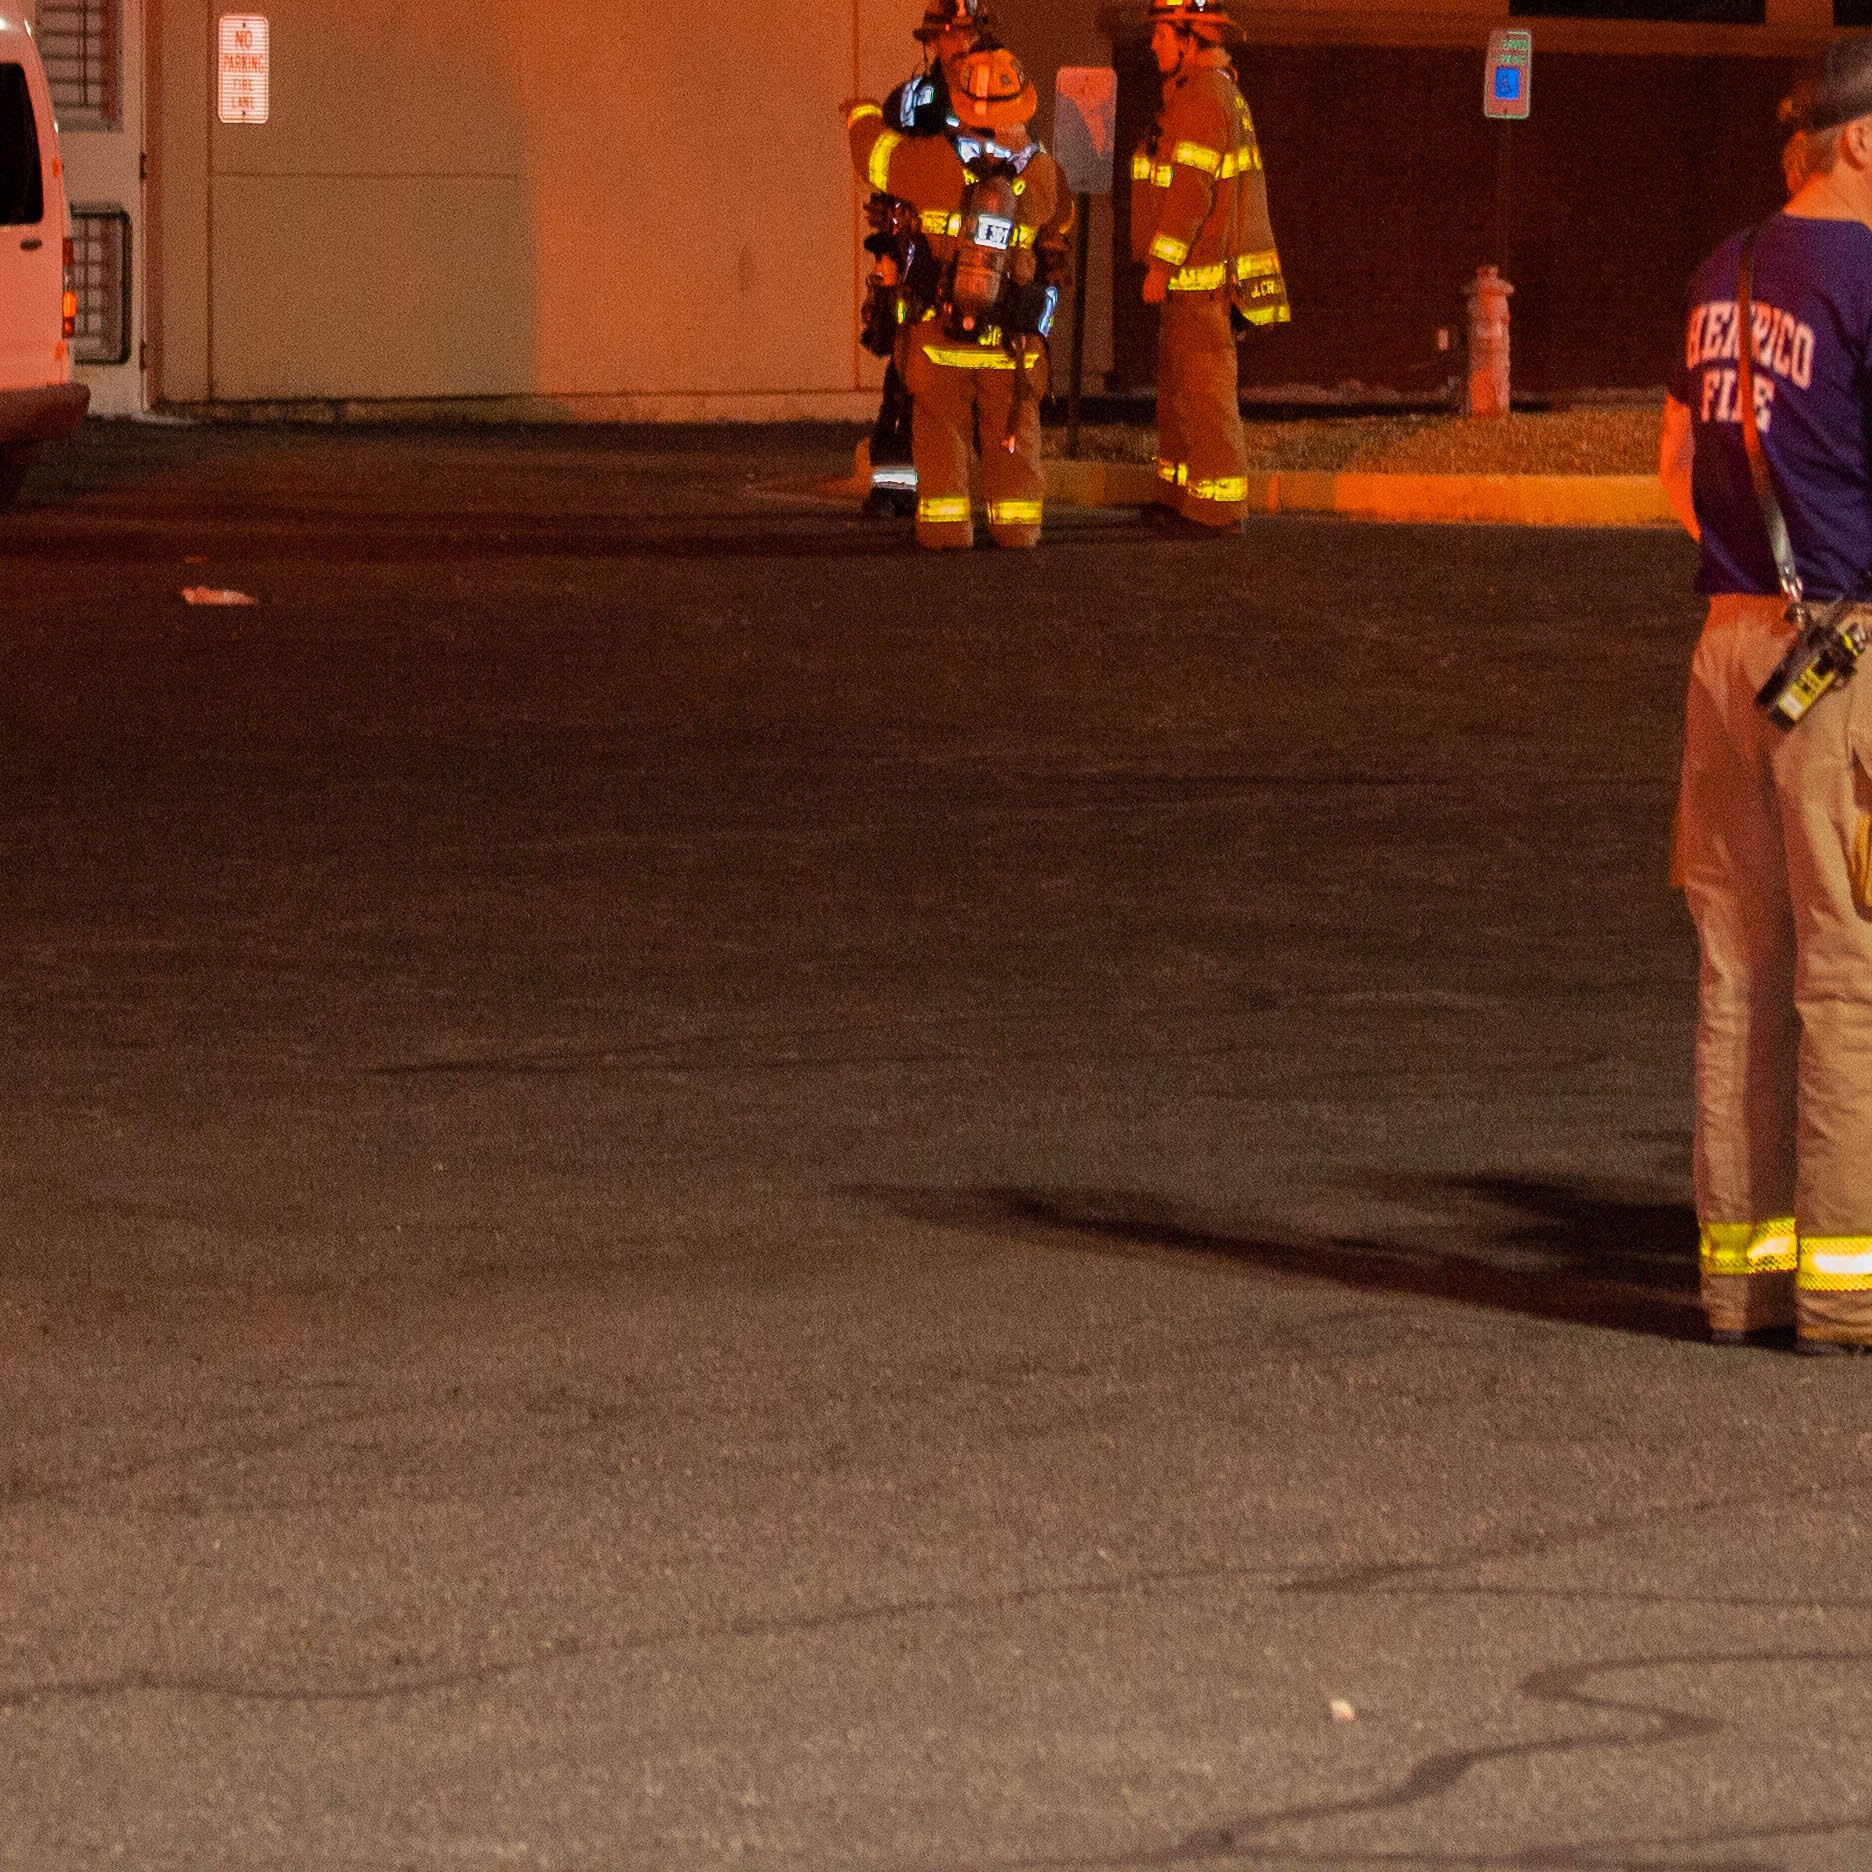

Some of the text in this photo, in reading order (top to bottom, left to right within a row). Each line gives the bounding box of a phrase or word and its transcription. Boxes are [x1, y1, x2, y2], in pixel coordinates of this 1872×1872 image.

[234, 30, 253, 48] NO
[223, 54, 265, 73] PARKING
[232, 96, 255, 110] LANE
